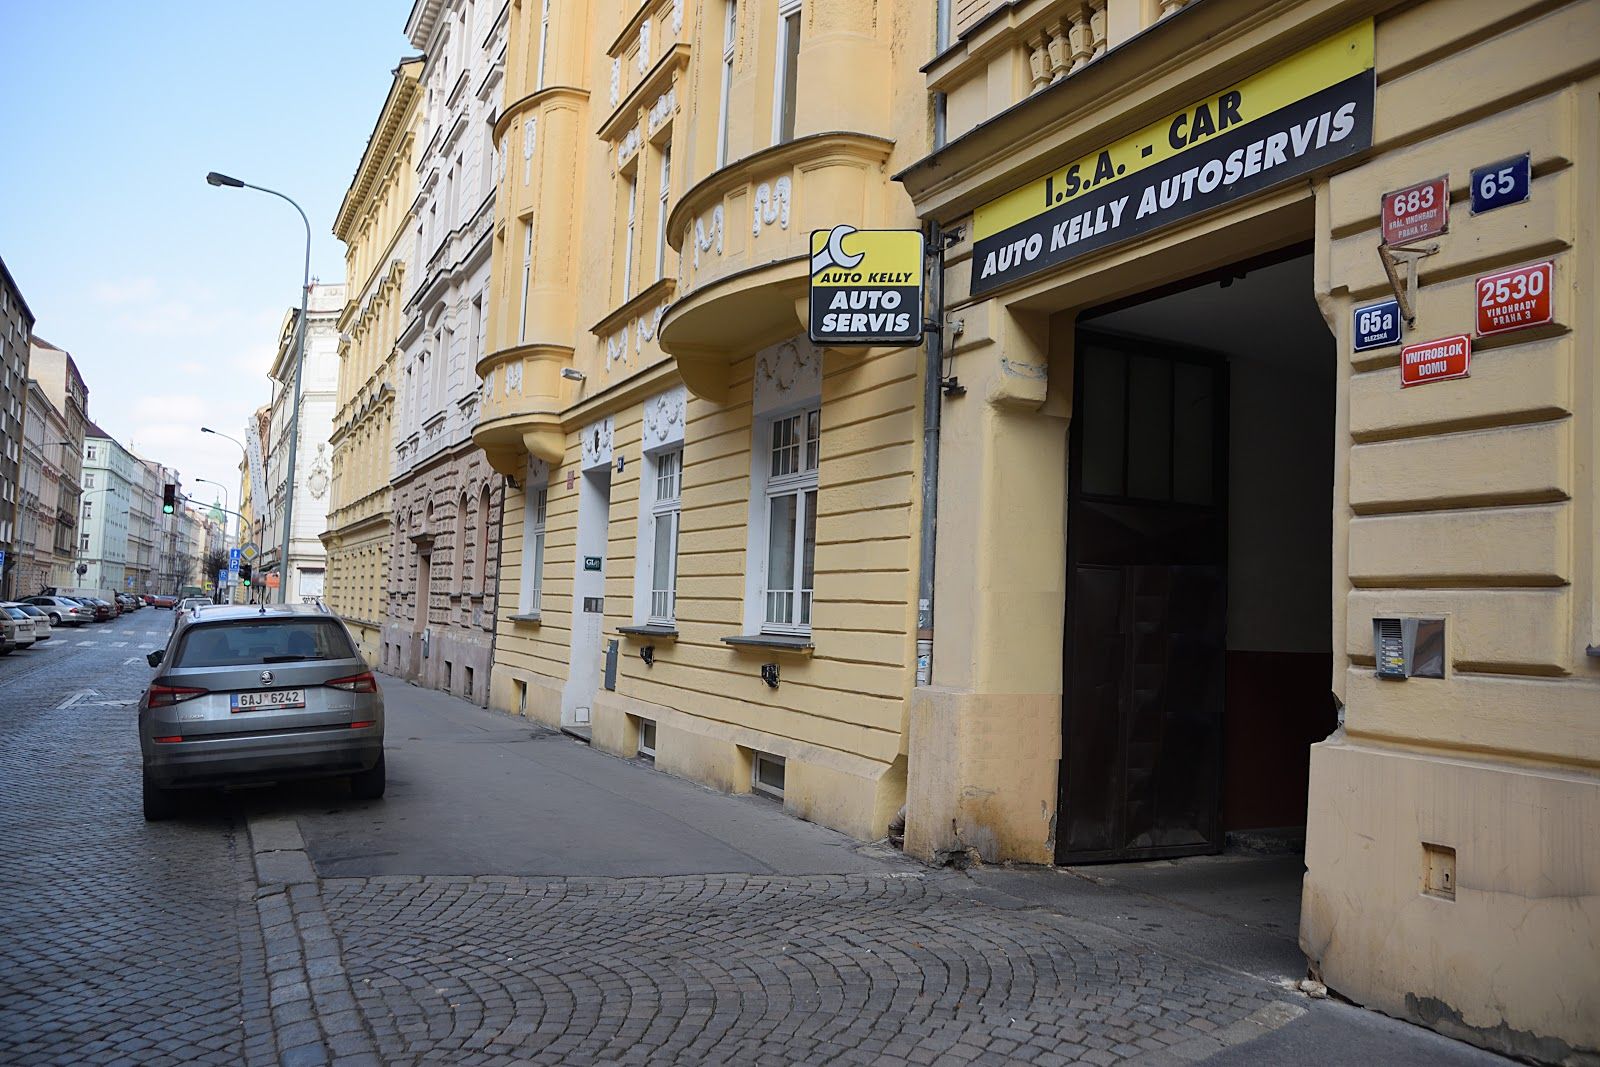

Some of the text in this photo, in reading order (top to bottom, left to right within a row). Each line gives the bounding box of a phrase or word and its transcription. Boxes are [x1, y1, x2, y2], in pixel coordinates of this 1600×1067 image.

[1044, 90, 1244, 207] I.S.A. - CAR
[980, 101, 1357, 279] AUTO KELLY AUTOSERVIS
[1480, 167, 1515, 199] 65
[1394, 185, 1434, 217] 683
[1398, 223, 1428, 239] PRAHA 12
[820, 272, 913, 283] AUTO KELLY
[1481, 271, 1544, 308] 2530
[828, 290, 901, 310] AUTO
[1486, 299, 1537, 318] VINOHRADY
[820, 313, 911, 332] SERVIS
[1360, 310, 1392, 335] 65a
[1493, 310, 1531, 326] PRAHA 3
[1364, 331, 1388, 343] SLEZSKÁ
[1405, 343, 1463, 365] VNITROBLOK
[1418, 360, 1447, 376] DOMU
[231, 560, 238, 568] P
[240, 691, 299, 706] 6AJ 6242
